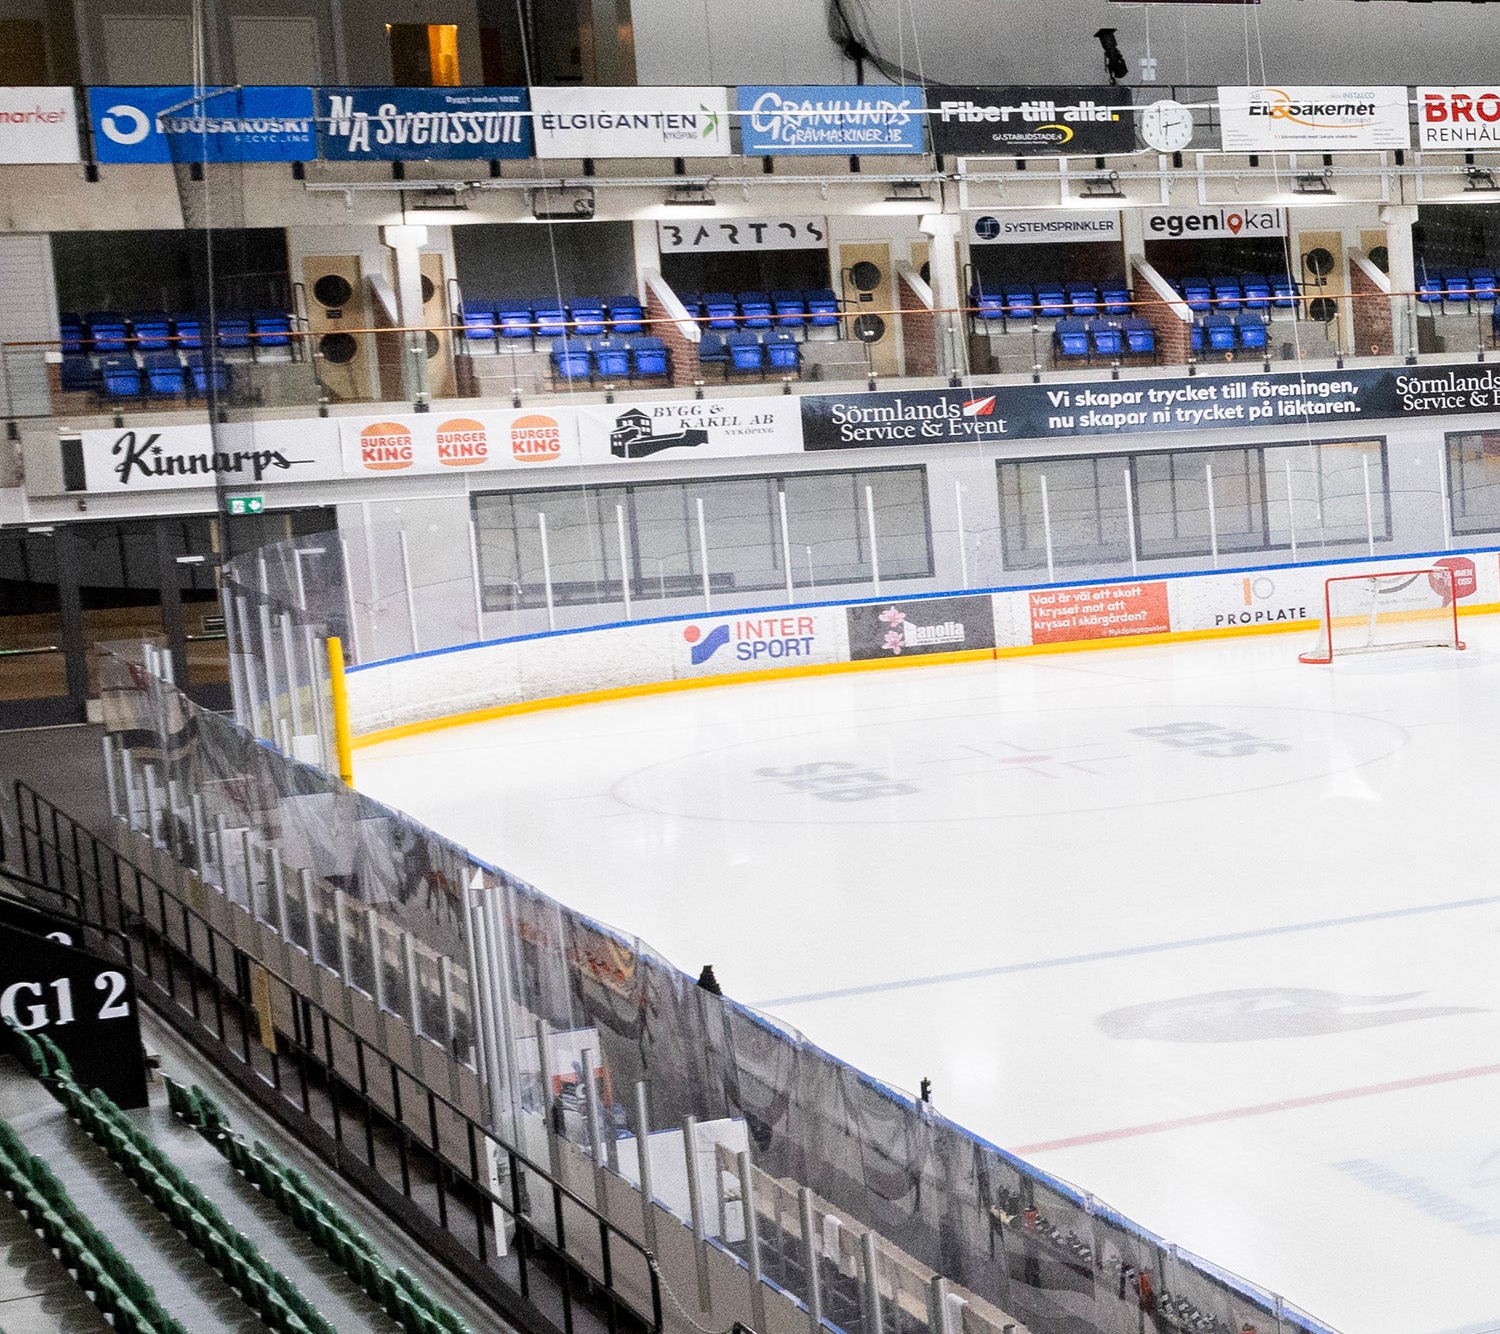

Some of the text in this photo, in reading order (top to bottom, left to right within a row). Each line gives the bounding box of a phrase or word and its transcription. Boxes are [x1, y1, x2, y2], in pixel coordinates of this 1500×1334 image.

[542, 112, 698, 130] ELGIGANTEN
[752, 92, 912, 139] GRANLUNDS
[940, 100, 1120, 123] Fiber till alla.
[376, 103, 522, 145] Svensson
[781, 124, 902, 145] GRÄVMASKINER AB
[1004, 220, 1115, 235] SYSTEMSPRINKLER
[1149, 207, 1282, 237] egenlokal
[1047, 377, 1361, 412] Vi skapar trycket till föreningen,
[1403, 392, 1466, 412] Service
[1470, 390, 1489, 407] &
[653, 404, 702, 419] BYGG
[679, 412, 775, 429] KAKEL AB
[831, 399, 961, 424] Sörmlands
[1048, 395, 1362, 431] nu skapar ni trycket på läktaren.
[435, 432, 488, 446] BURGER
[510, 427, 560, 441] BURGER
[841, 416, 1008, 442] Service & Event
[359, 436, 413, 450] BURGER
[437, 443, 488, 458] KING
[512, 437, 561, 453] KING
[111, 430, 315, 485] Kinnarps
[361, 447, 413, 462] KING
[1031, 586, 1142, 605] Vad är väl ett skott
[1038, 600, 1127, 619] krysset mot att
[1215, 606, 1308, 626] PROPLATE
[736, 615, 814, 640] INTER
[1033, 610, 1148, 632] kryssa skärgården?
[736, 636, 815, 661] SPORT
